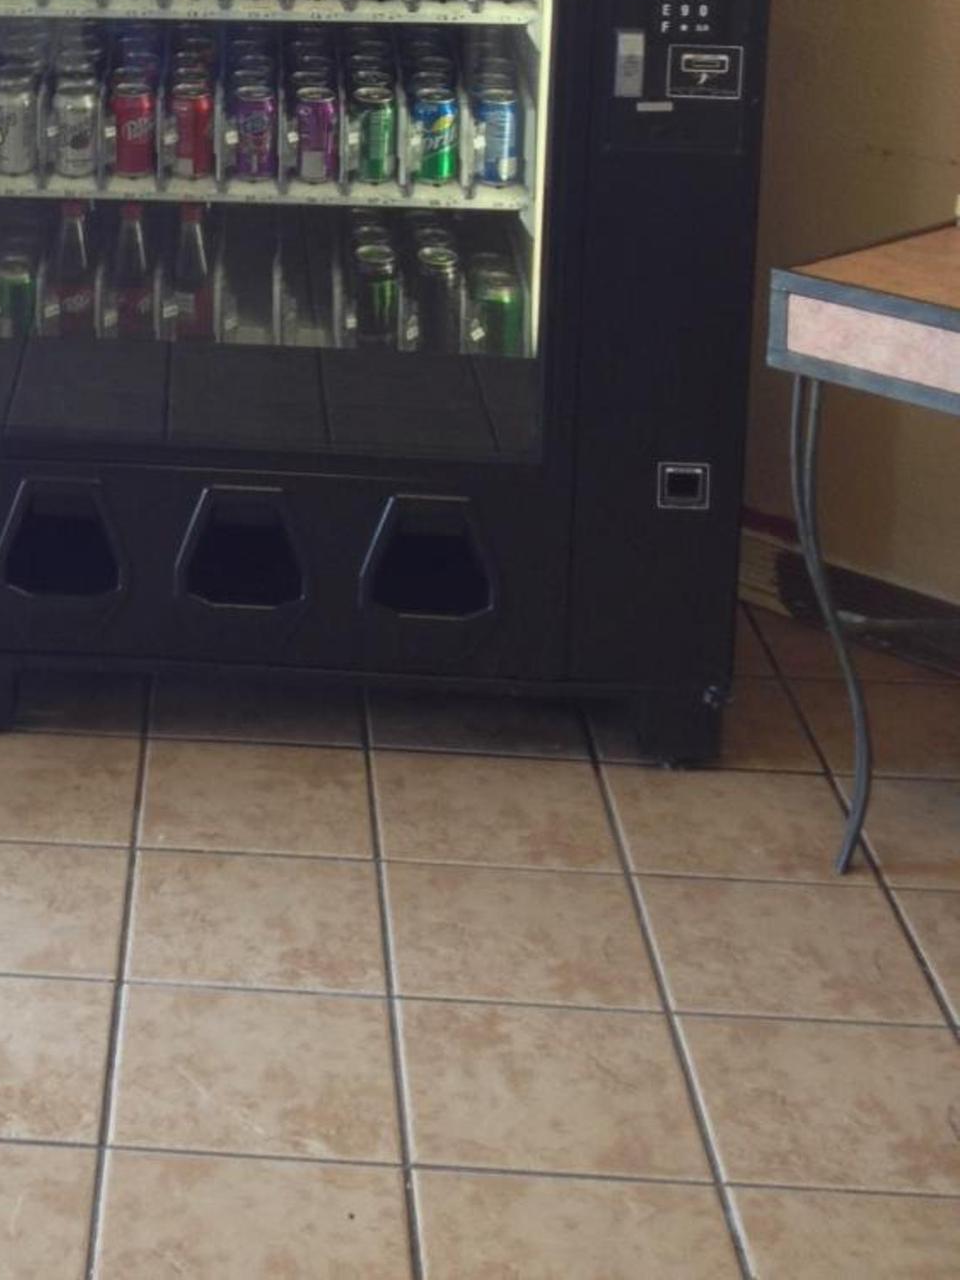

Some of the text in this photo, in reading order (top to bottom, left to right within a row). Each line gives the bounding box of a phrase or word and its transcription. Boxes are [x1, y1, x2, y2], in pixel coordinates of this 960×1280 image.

[661, 4, 708, 17] E 9 0
[661, 21, 671, 33] F
